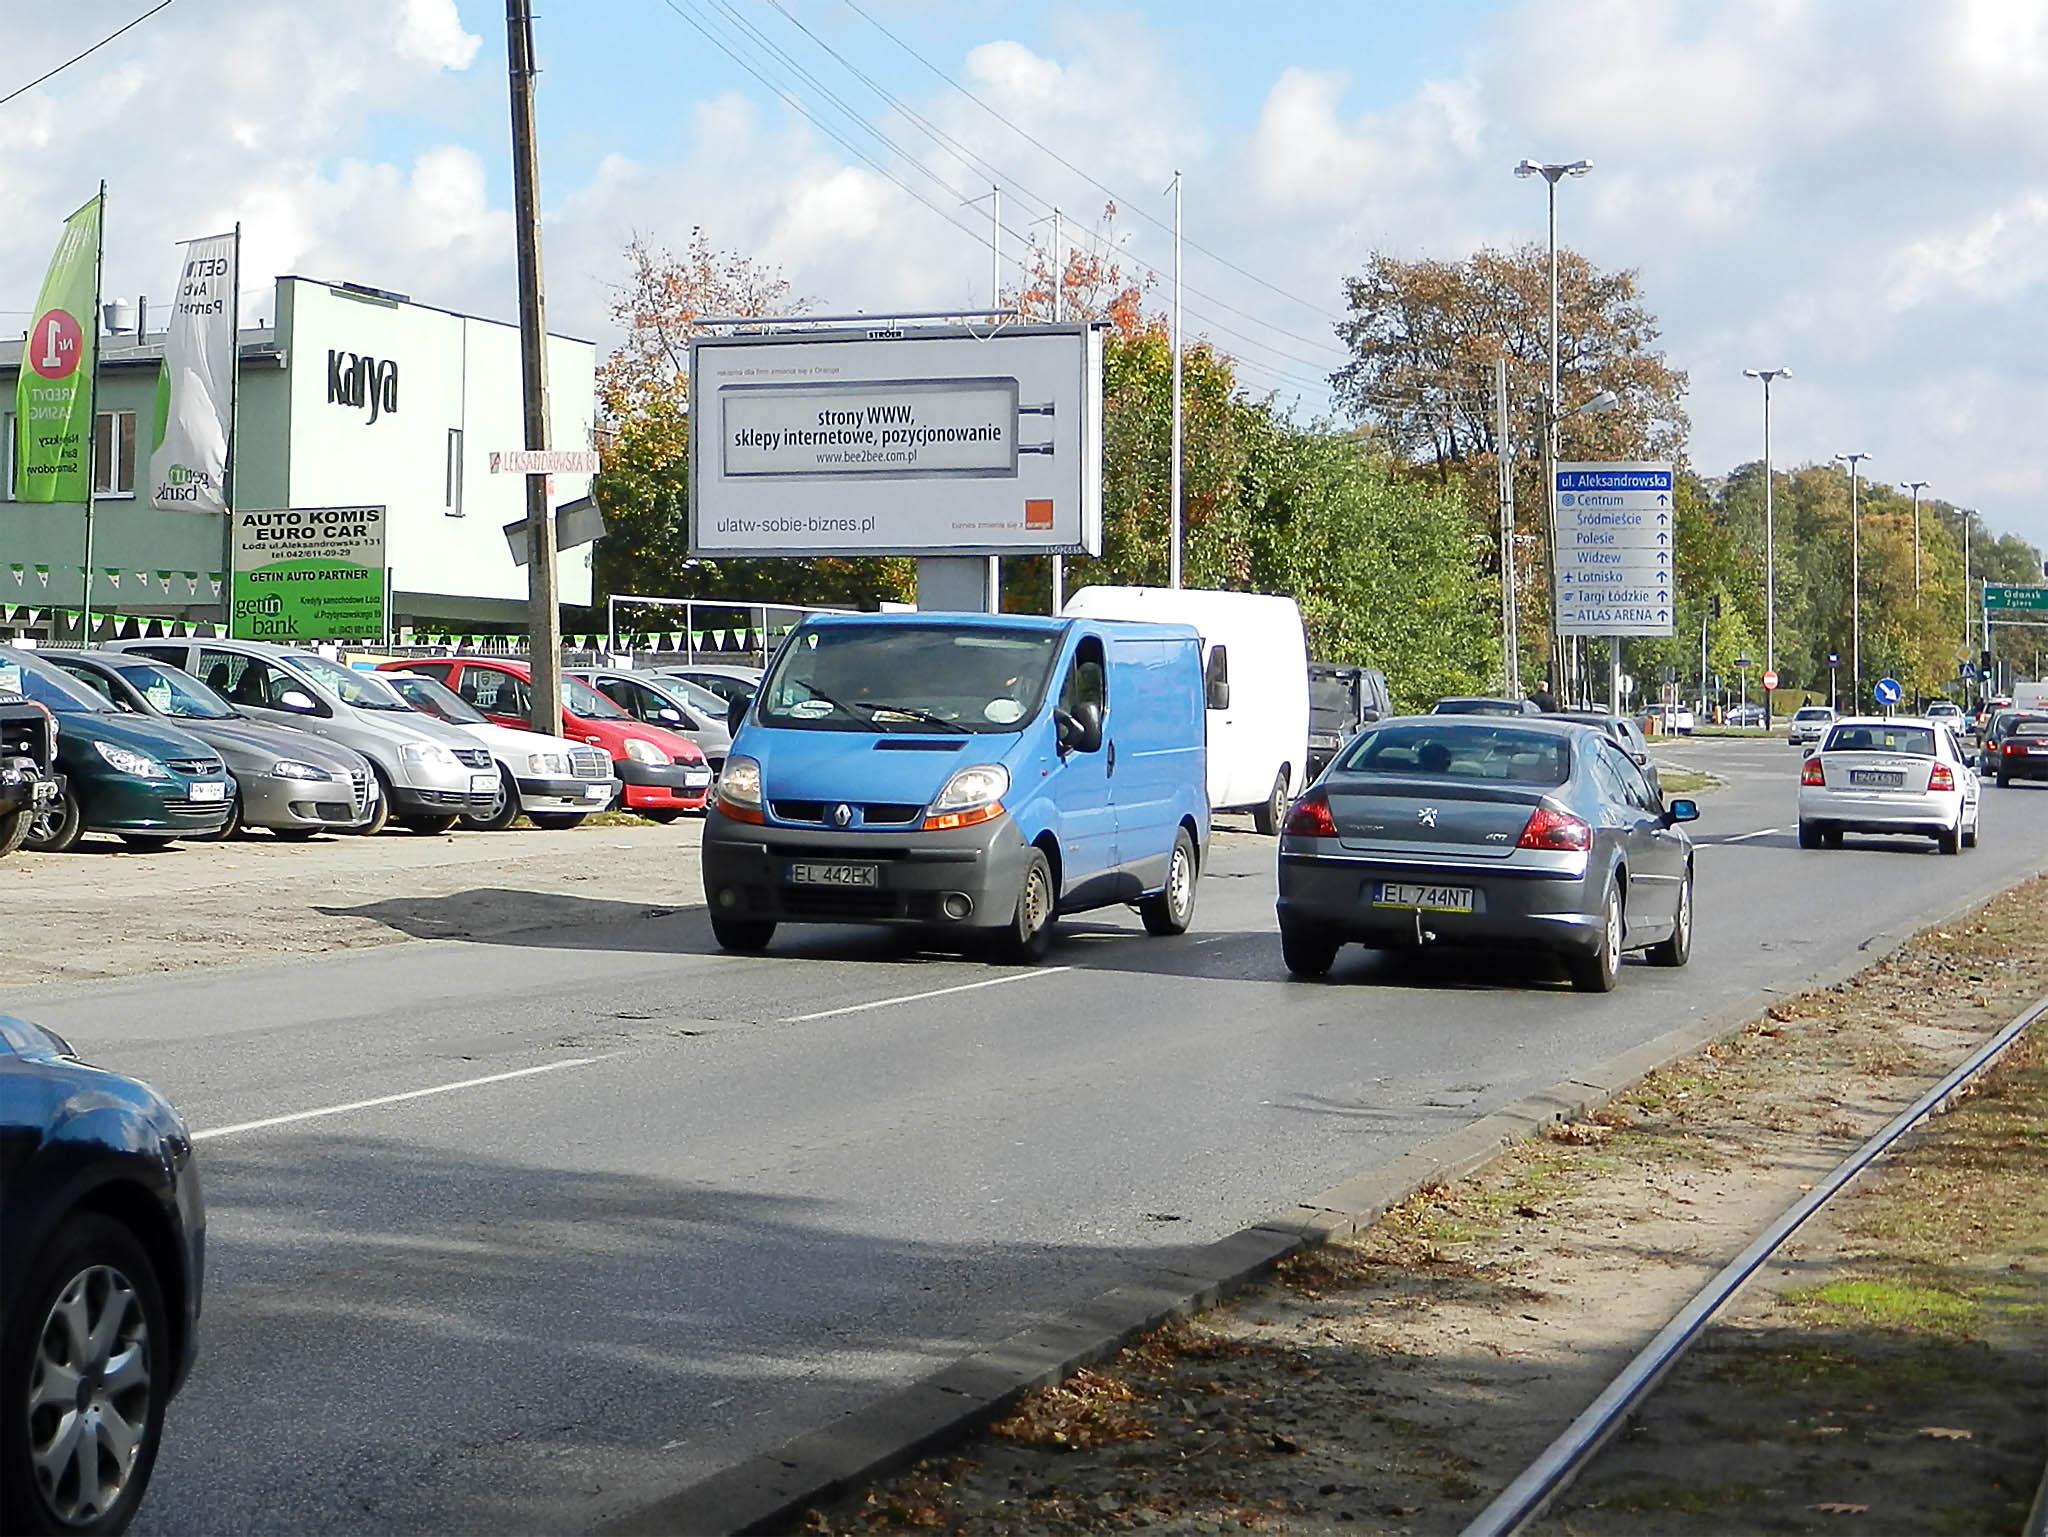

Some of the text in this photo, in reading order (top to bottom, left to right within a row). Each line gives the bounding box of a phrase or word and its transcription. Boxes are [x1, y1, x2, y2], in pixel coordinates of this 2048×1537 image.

[817, 406, 915, 428] strony WWW,
[734, 423, 1001, 451] sklepy internetowe, pozycjonowanie
[816, 449, 917, 464] www.bee2bee.com.pl
[1561, 473, 1667, 487] ul. Aleksandrowska
[1577, 495, 1624, 506] Centrum
[242, 509, 380, 527] AUTO KOMIS
[717, 516, 875, 534] ulatw-sobie-biznes.pl
[1577, 511, 1642, 525] Śródmieście
[256, 525, 367, 541] EURO CAR
[1577, 532, 1615, 544] Polesie
[1577, 552, 1621, 563] Widzew
[250, 569, 368, 582] GETIN AUTO PARTNER
[1577, 571, 1623, 582] Lotnisko
[1578, 590, 1605, 606] Targi
[236, 594, 281, 619] getin
[1577, 609, 1652, 621] ATLAS ARENA
[252, 615, 299, 635] bank
[795, 865, 872, 884] EL 442EK
[1384, 886, 1470, 907] EL 744NT
